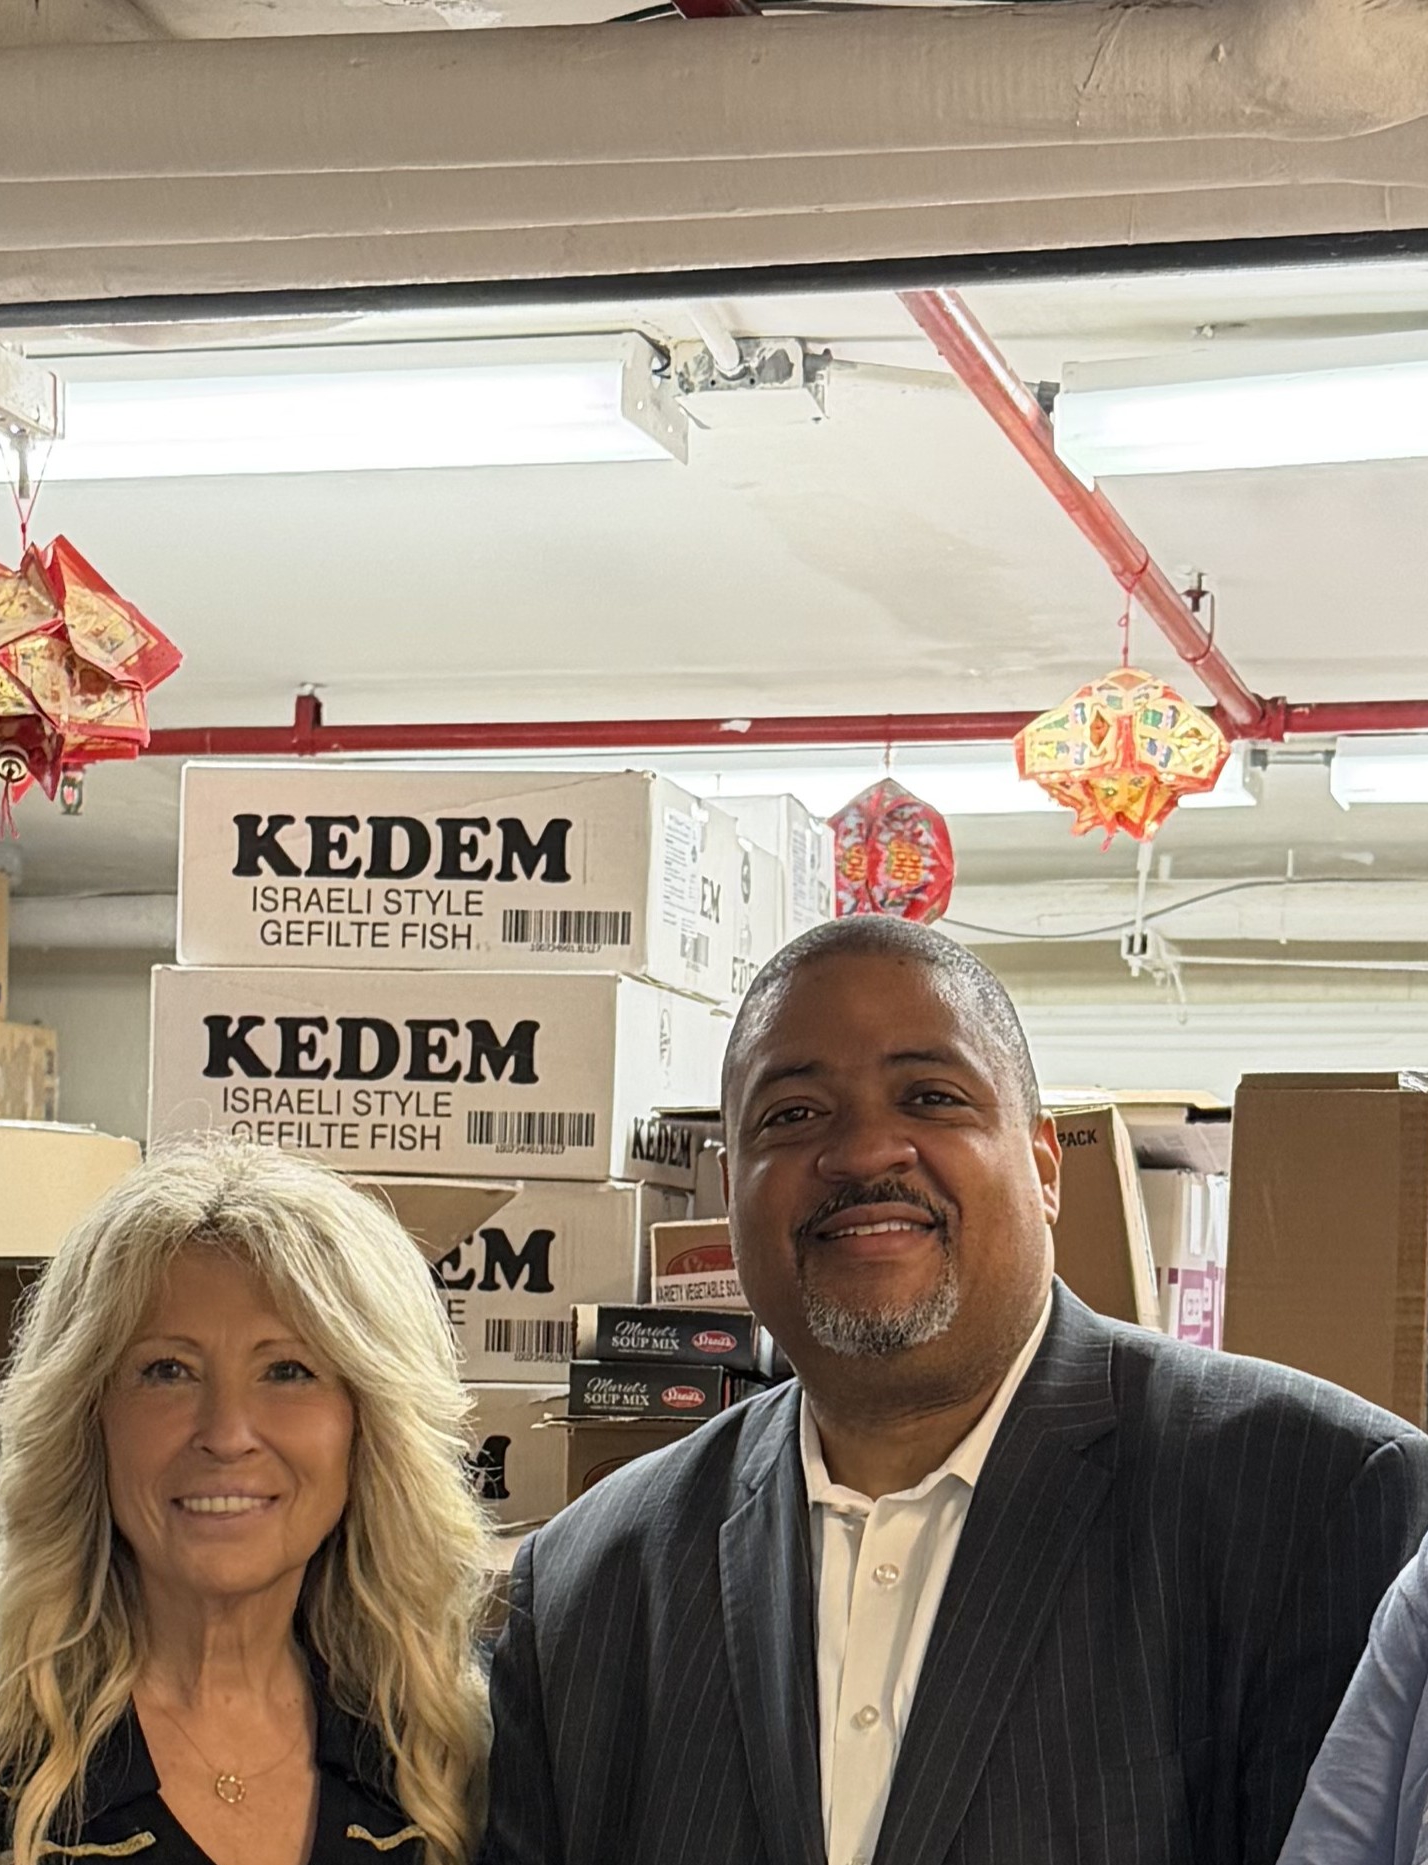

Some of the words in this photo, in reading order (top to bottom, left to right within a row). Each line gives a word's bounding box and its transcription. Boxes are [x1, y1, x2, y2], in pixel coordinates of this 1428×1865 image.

[233, 814, 572, 882] KEDEM
[253, 887, 371, 913] ISRAELI
[384, 889, 482, 916] STYLE
[261, 920, 389, 947] GEFILTE
[402, 923, 471, 949] FISH
[203, 1015, 540, 1084] KEDEM
[224, 1087, 340, 1114] ISRAELI
[353, 1090, 451, 1117] STYLE
[371, 1124, 440, 1150] FISH
[632, 1117, 692, 1169] KEDEM
[612, 1336, 649, 1349] SOUP
[652, 1338, 680, 1350] MIX
[584, 1392, 621, 1405] SOUP
[623, 1394, 650, 1406] MIX
